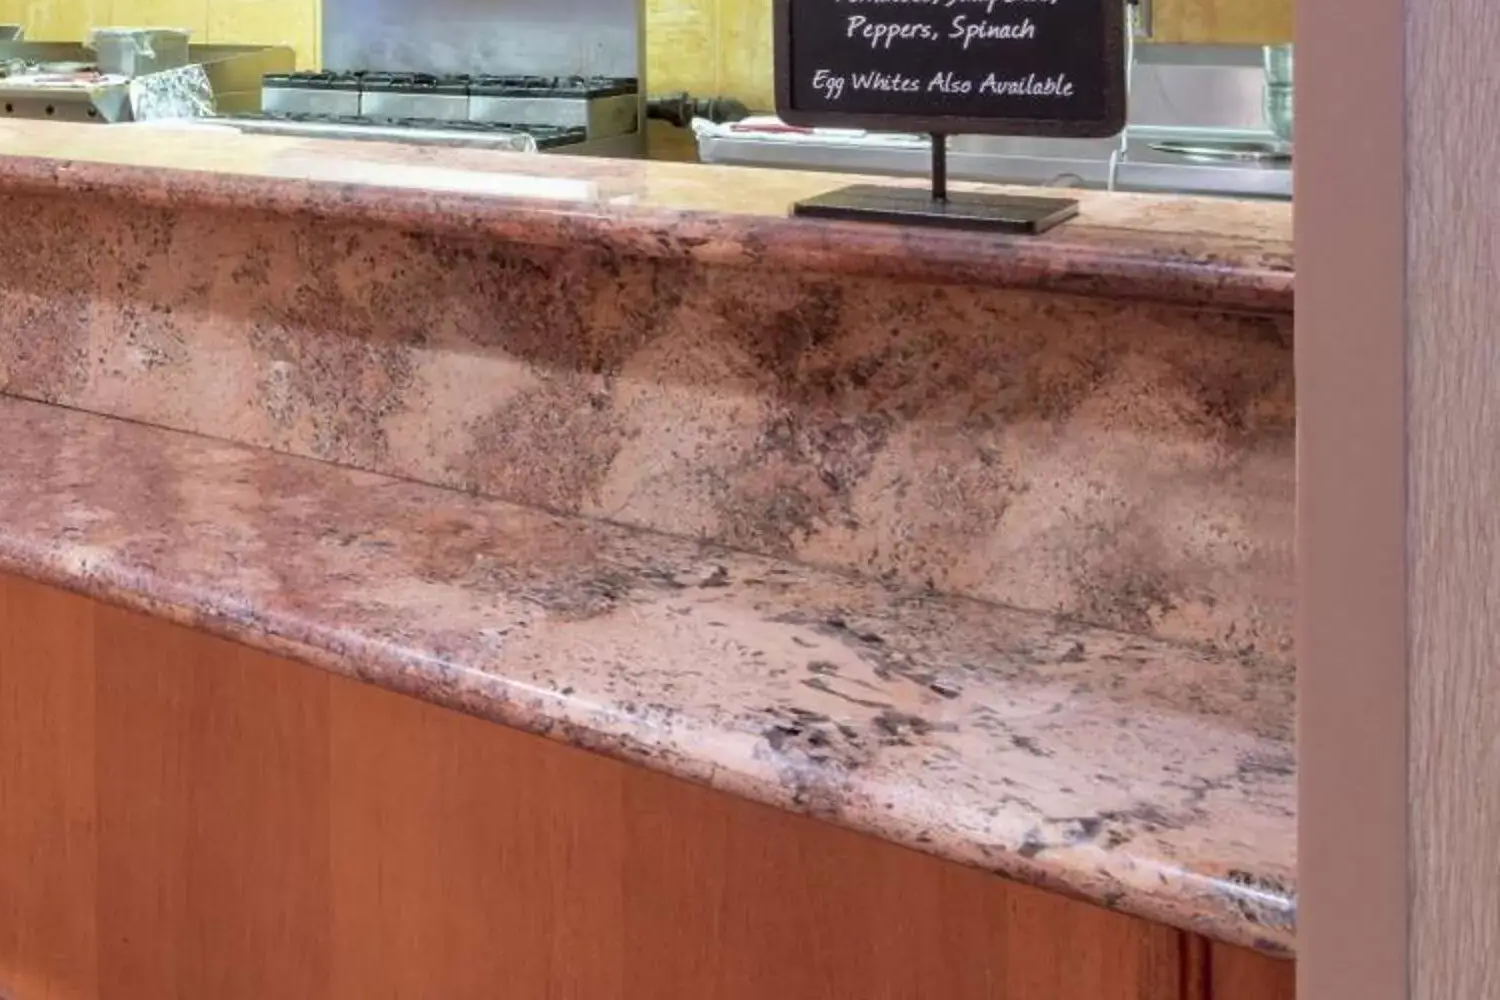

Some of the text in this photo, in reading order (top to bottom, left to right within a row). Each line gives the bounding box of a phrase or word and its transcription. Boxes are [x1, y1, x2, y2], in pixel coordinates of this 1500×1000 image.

[847, 15, 1035, 49] Peppers, Spinach
[813, 69, 1073, 99] Egg Whites Also Available
